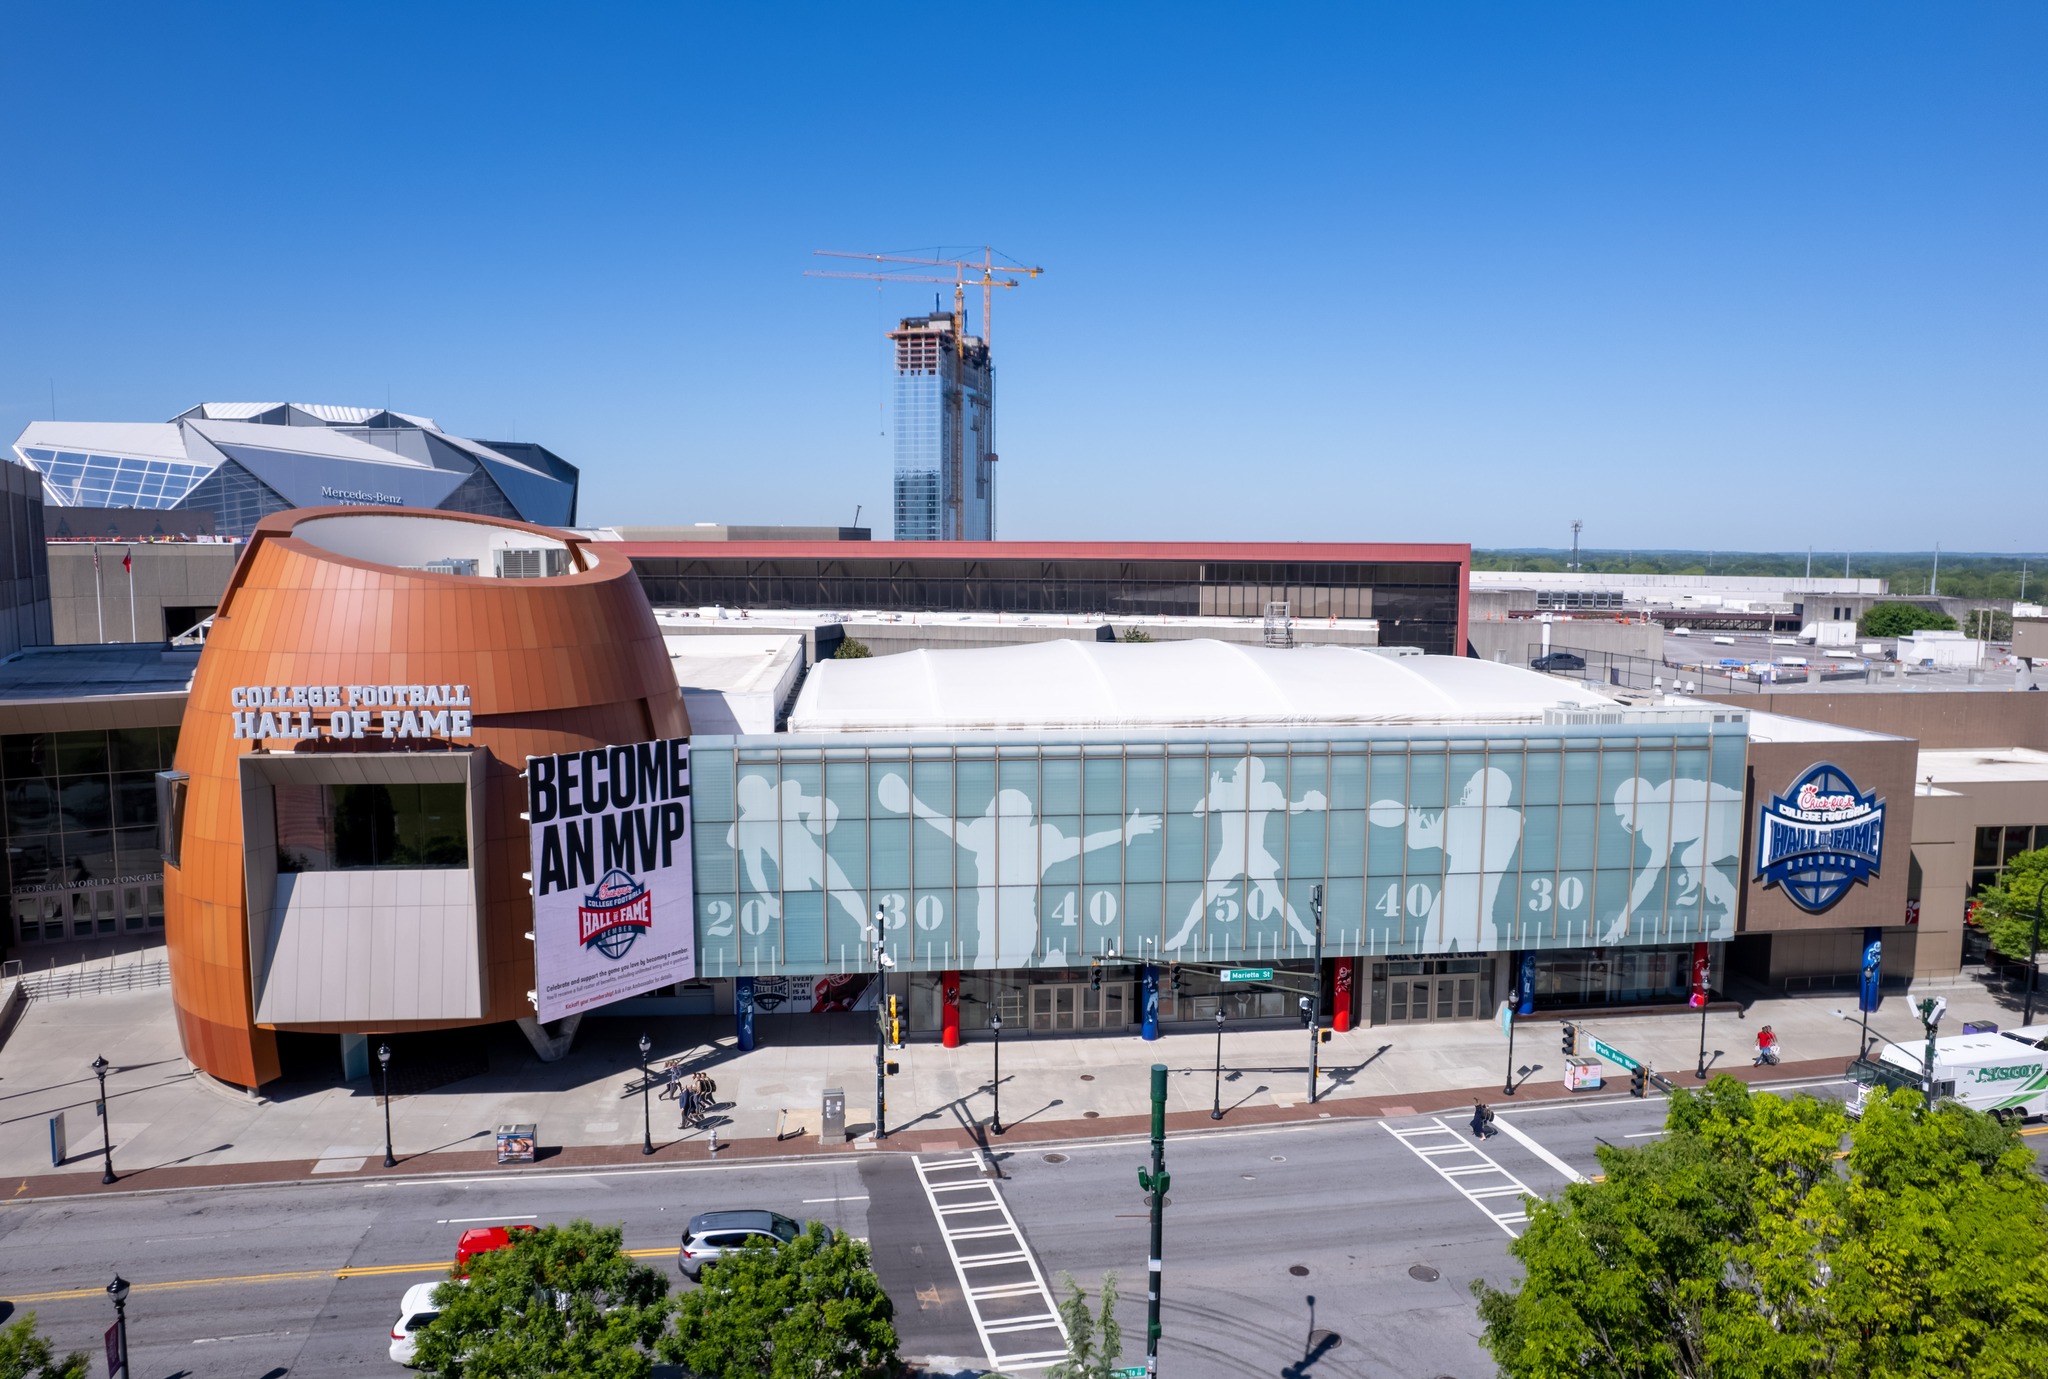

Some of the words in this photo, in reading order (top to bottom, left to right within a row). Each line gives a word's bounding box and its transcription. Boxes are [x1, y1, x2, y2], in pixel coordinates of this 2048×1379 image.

[321, 486, 402, 504] Mercedes-Benz
[232, 686, 342, 708] COLLEGE
[348, 685, 470, 707] FOOTBALL
[232, 711, 322, 740] HALL
[330, 711, 371, 738] OF
[382, 710, 473, 738] FAME
[530, 738, 690, 824] BECOME
[1780, 804, 1822, 822] COLLEGE
[1822, 803, 1871, 822] FOOTBALL
[539, 818, 594, 896] AN
[602, 802, 684, 876] MVP
[1770, 820, 1819, 861] HALL
[1831, 817, 1881, 857] FAME
[10, 883, 66, 894] GEORGIA
[68, 878, 110, 888] WORLD
[588, 900, 614, 908] COLLEGE
[614, 888, 642, 906] FOOTBALL
[1376, 884, 1432, 917] 40
[1529, 877, 1584, 912] 30
[582, 912, 612, 938] HALL
[620, 896, 648, 922] FAME
[707, 900, 770, 936] 20
[881, 894, 944, 931] 30
[1052, 890, 1117, 926] 40
[1215, 887, 1274, 922] 50
[602, 925, 632, 939] MEMBER
[547, 982, 570, 992] Celebrate
[571, 977, 579, 985] and
[581, 973, 598, 982] support
[1597, 1044, 1610, 1056] Park
[1612, 1052, 1622, 1064] Ave
